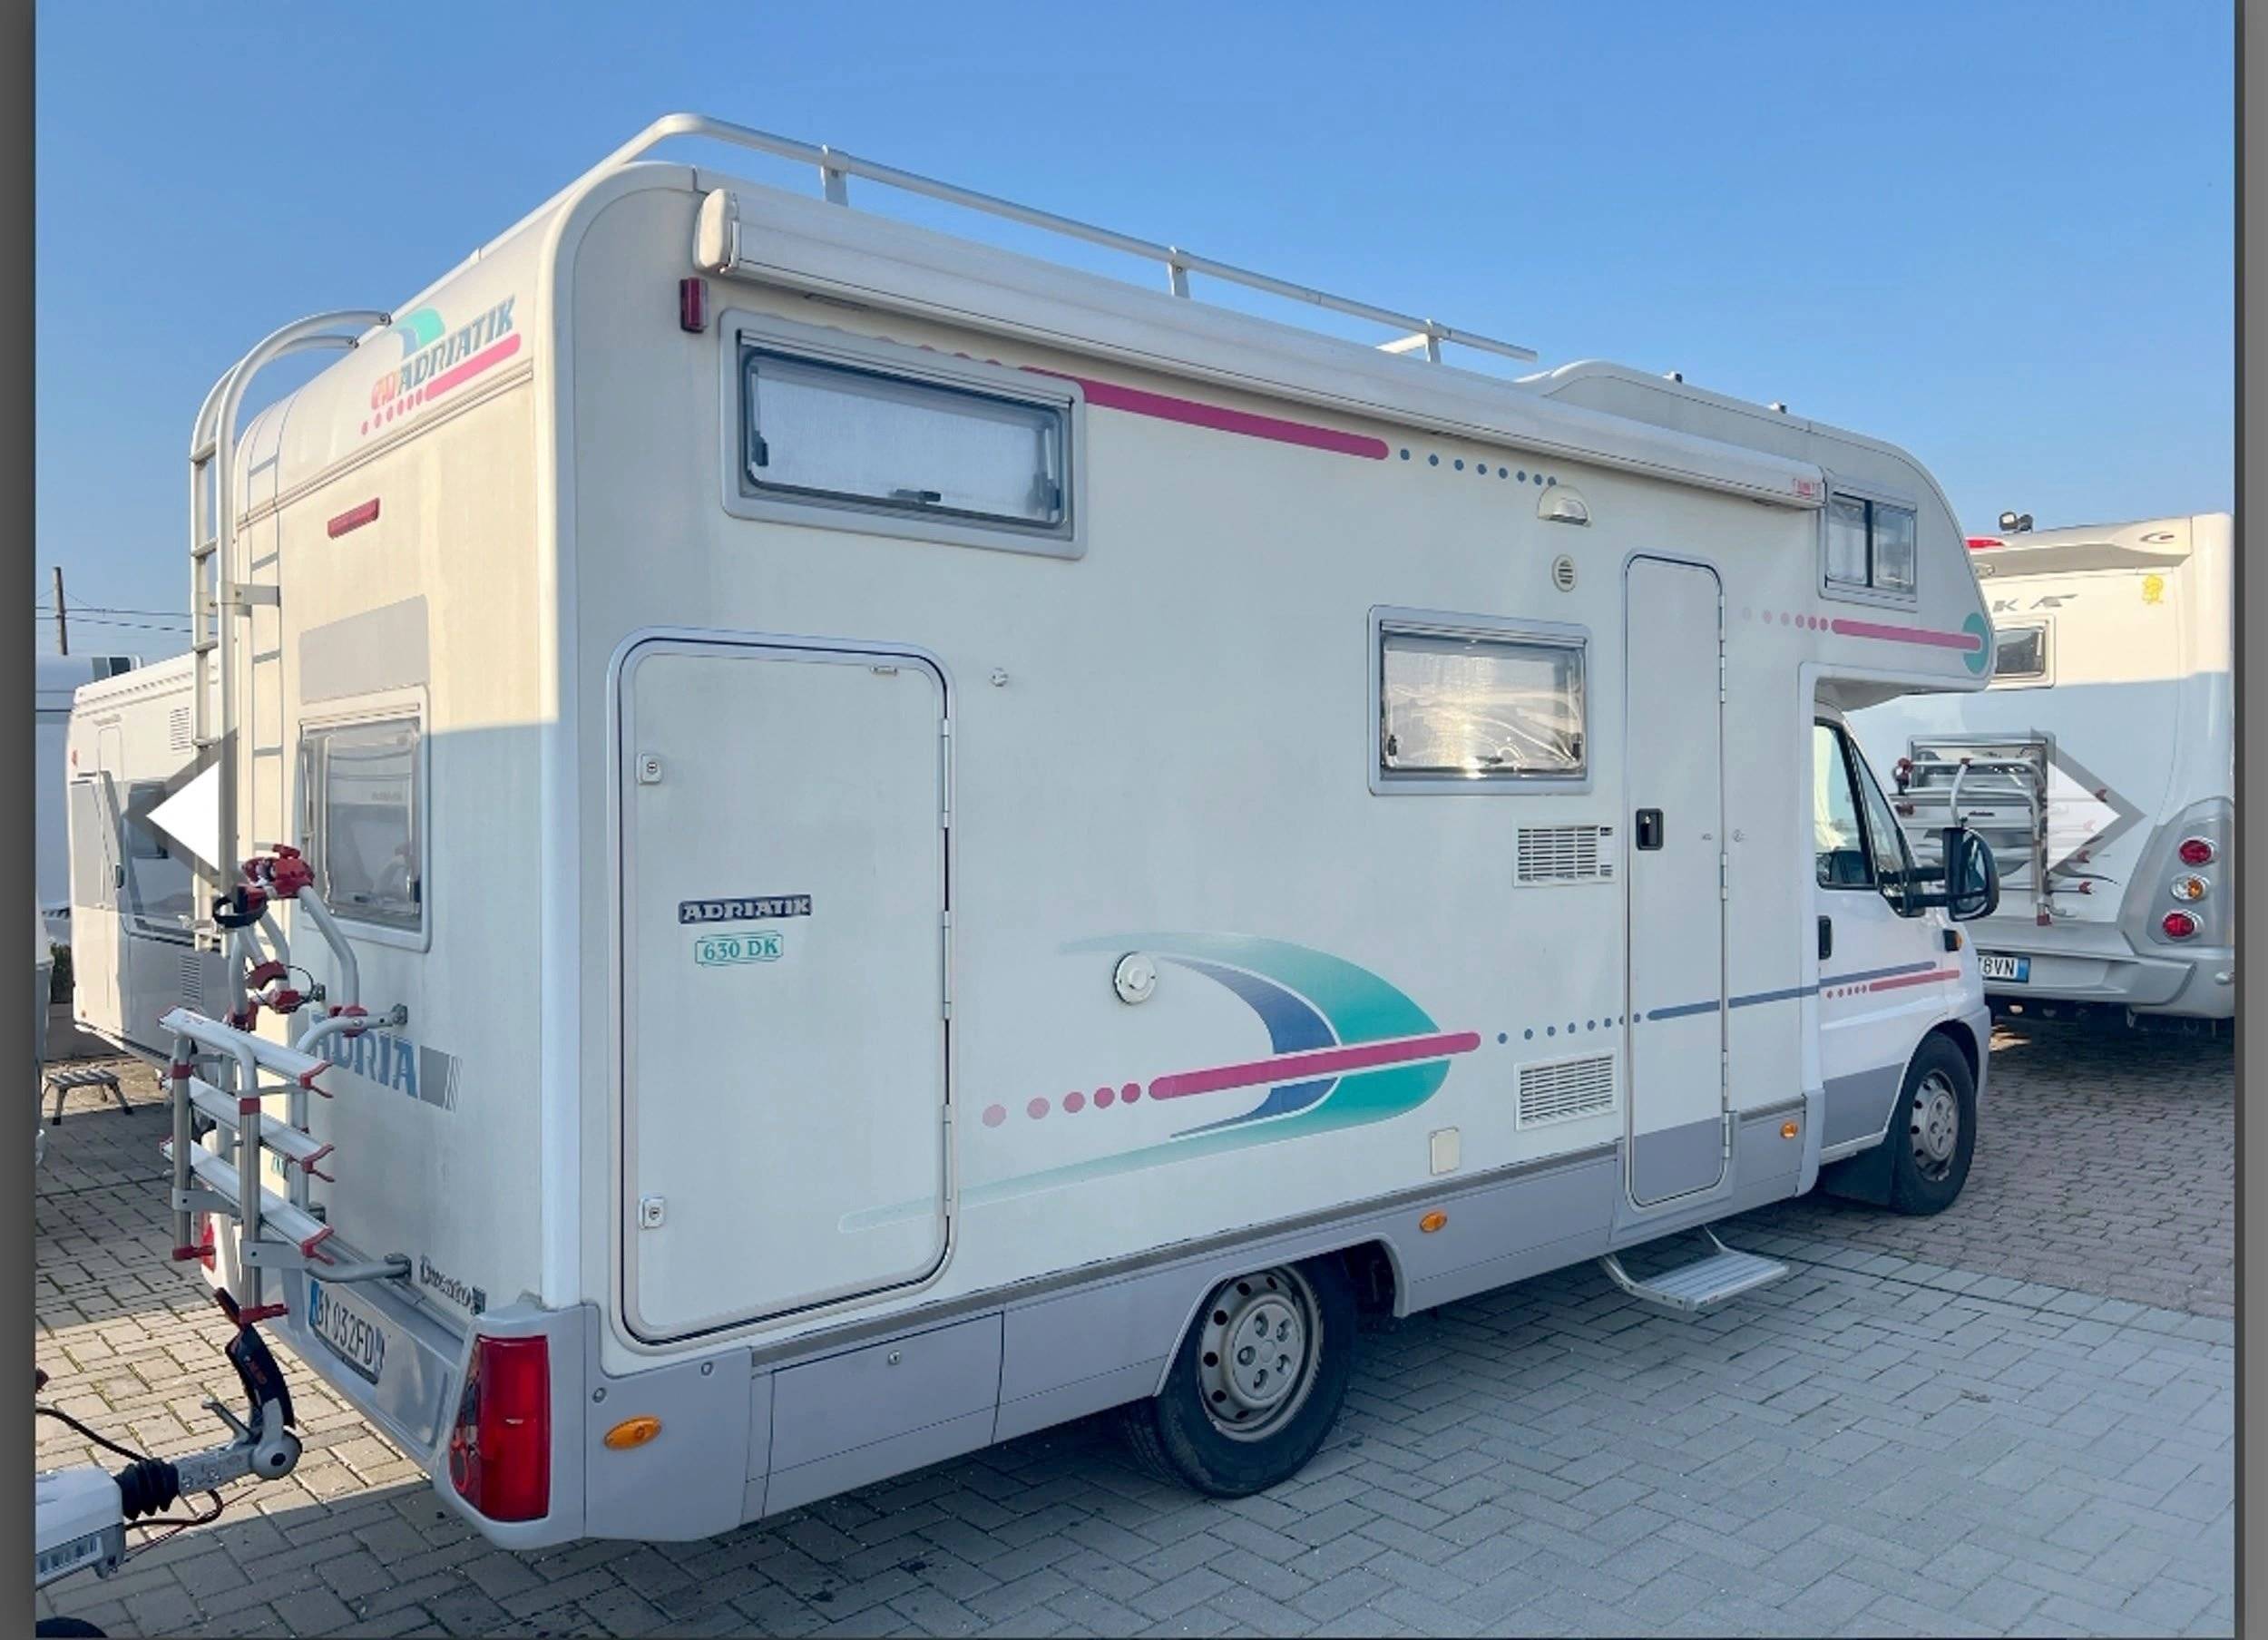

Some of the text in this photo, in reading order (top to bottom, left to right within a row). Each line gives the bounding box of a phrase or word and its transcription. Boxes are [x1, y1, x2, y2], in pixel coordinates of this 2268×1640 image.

[683, 898, 810, 922] ADRIATIK
[703, 935, 778, 961] 630 DK
